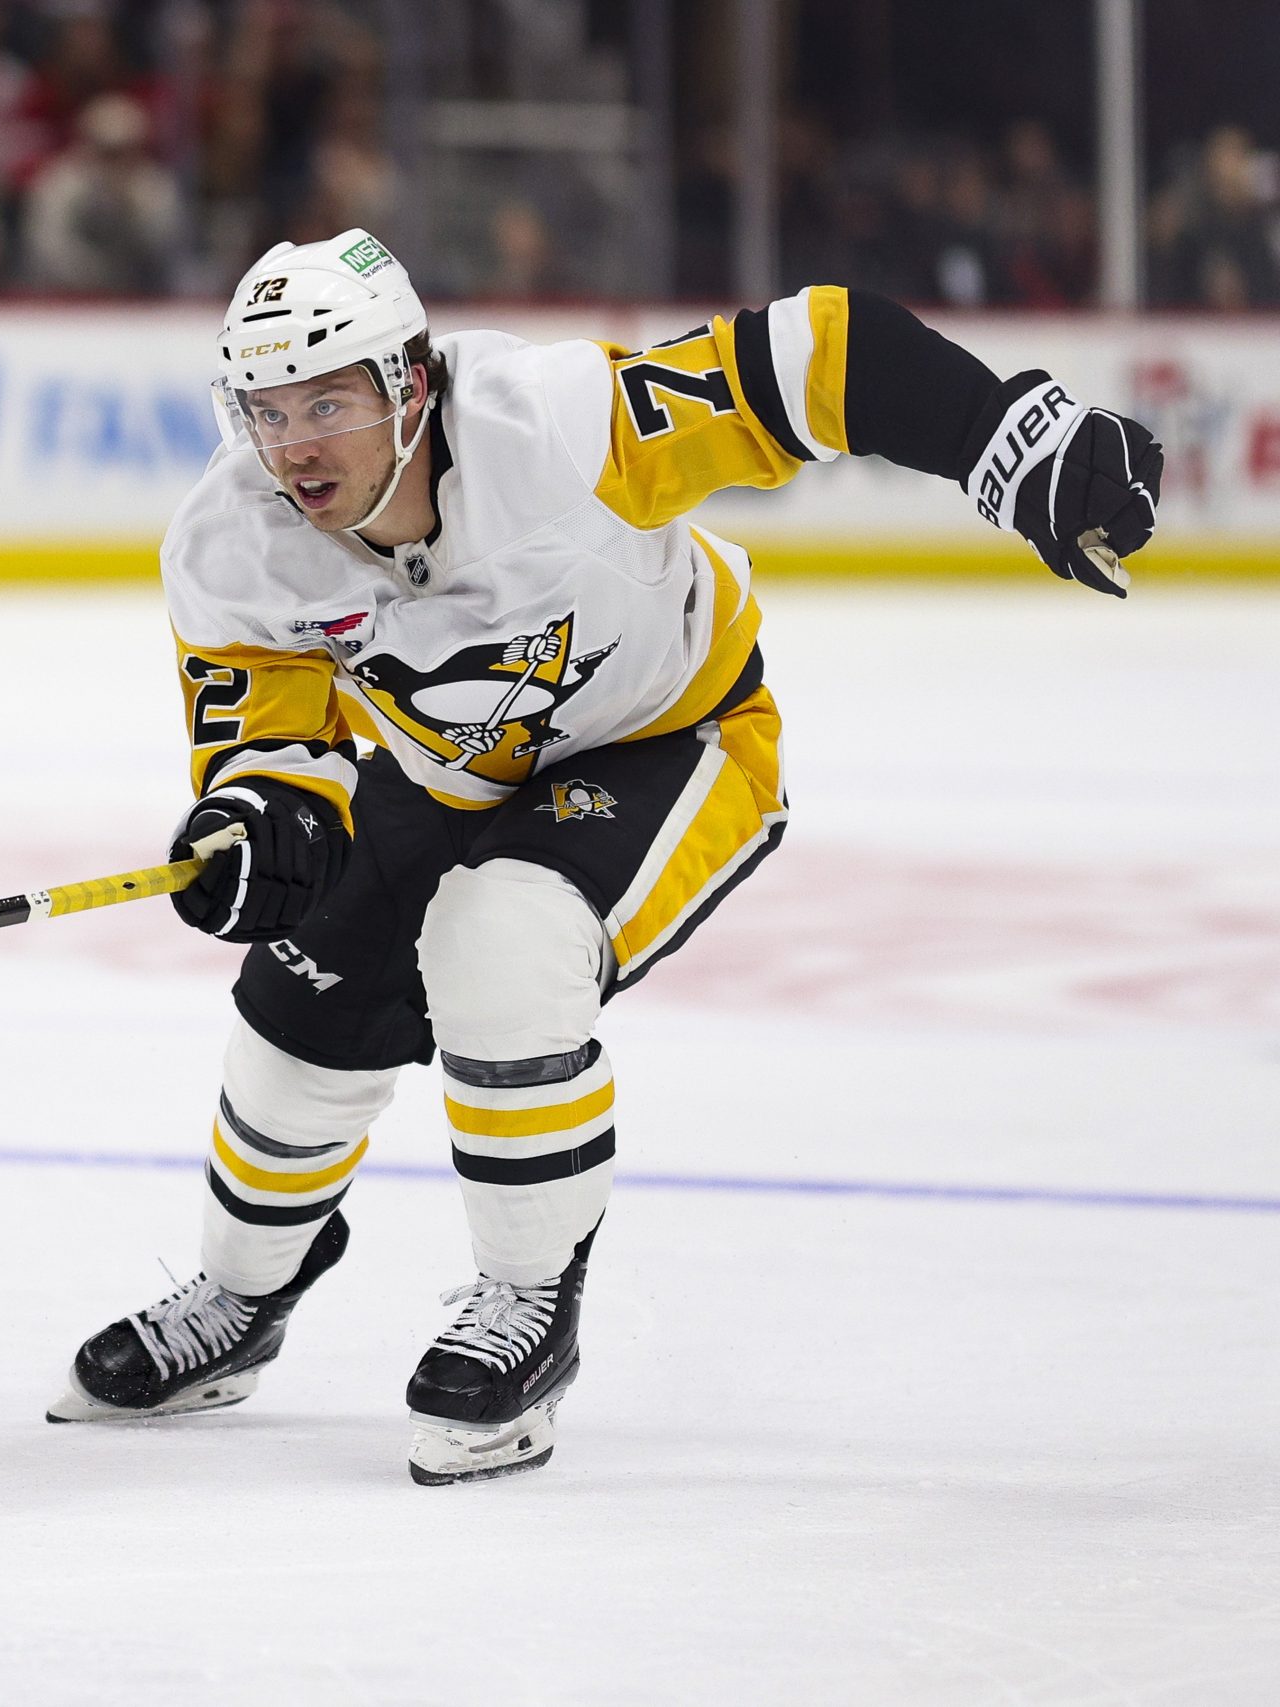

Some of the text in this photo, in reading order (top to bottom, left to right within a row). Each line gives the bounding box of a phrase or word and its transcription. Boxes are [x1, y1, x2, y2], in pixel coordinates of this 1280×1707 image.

[342, 237, 388, 271] MSA
[246, 278, 288, 307] 72
[240, 340, 291, 358] CCM
[977, 385, 1075, 529] BAUER
[522, 1353, 554, 1395] BAUER
